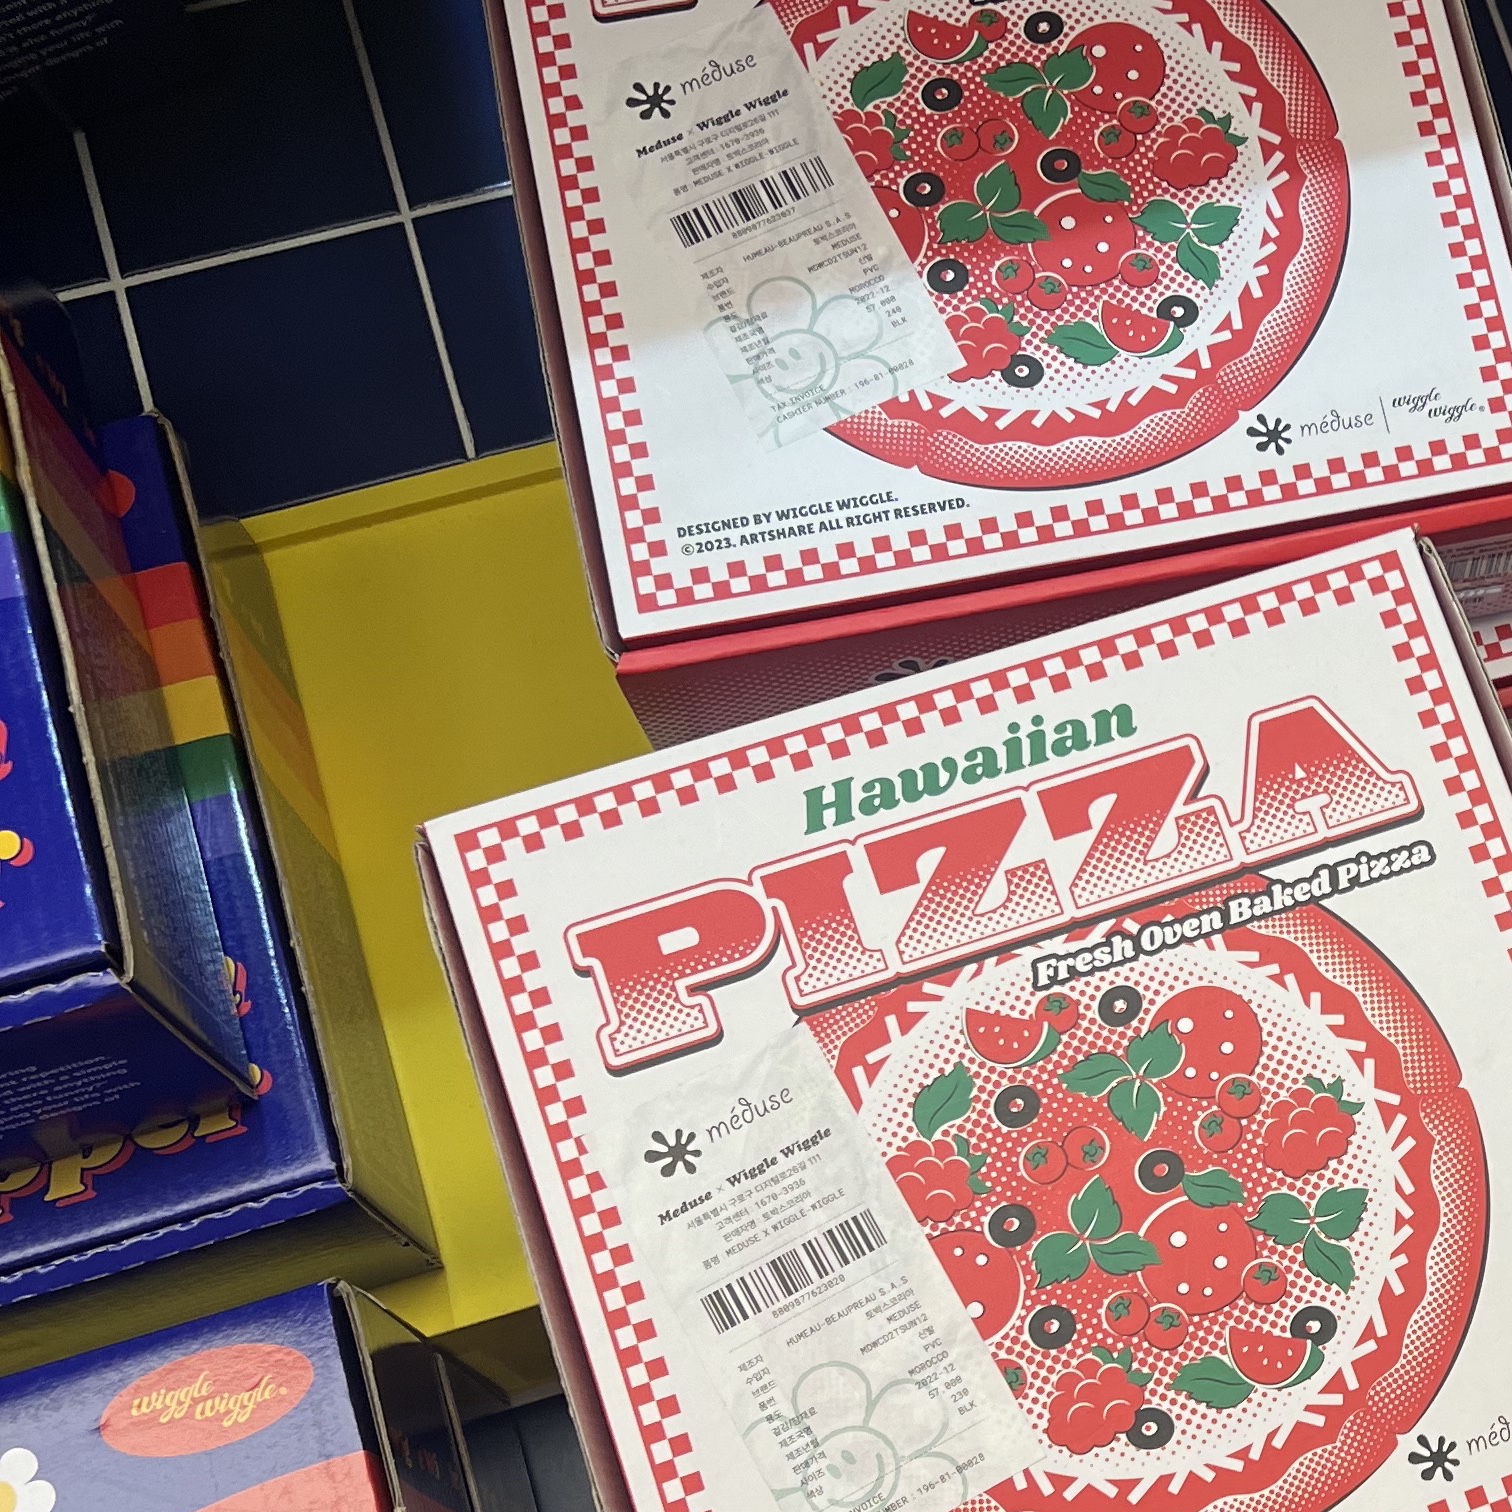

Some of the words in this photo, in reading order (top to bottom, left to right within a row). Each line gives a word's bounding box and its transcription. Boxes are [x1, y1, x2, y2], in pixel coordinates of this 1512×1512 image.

[680, 53, 756, 95] méduse
[636, 132, 683, 158] Meduse
[696, 108, 741, 131] Wiggle
[743, 88, 788, 111] Wiggle
[693, 170, 724, 186] MEDUSE
[831, 233, 862, 250] MEDUSE
[771, 400, 787, 412] TAX
[789, 384, 828, 405] INVOICE
[777, 400, 813, 423] CASHIER
[813, 389, 846, 407] NUMBER
[1392, 387, 1441, 413] wiggle
[1300, 409, 1374, 437] méduse
[677, 517, 749, 538] DESIGNED
[753, 512, 772, 525] BY
[775, 502, 834, 521] WIGGLE
[836, 491, 898, 510] WIGGLE.
[740, 523, 815, 546] ARTSHARE
[819, 519, 843, 532] ALL
[846, 510, 890, 527] RIGHT
[894, 497, 970, 519] RESERVED.
[804, 702, 1138, 835] Hawaiian
[565, 695, 1424, 1074] PIZZA
[1034, 933, 1136, 988] Fresh
[1139, 907, 1224, 955] Oven
[1227, 872, 1333, 925] Baked
[1336, 842, 1432, 892] Pizza
[706, 1085, 793, 1143] méduse
[658, 1190, 712, 1225] Meduse
[726, 1154, 778, 1188] Wiggle
[780, 1126, 832, 1159] Wiggle
[686, 1203, 728, 1230] 서울특별시
[729, 1190, 753, 1206] 구로구
[725, 1234, 761, 1257] MEDUSE
[762, 1229, 770, 1237] X
[771, 1188, 845, 1232] WIGGLE-WIGGLE
[737, 1354, 764, 1372] 제조자
[786, 1293, 876, 1347] HUMEAU-BEAUPREAU
[752, 1380, 776, 1398] 브랜드
[886, 1300, 922, 1324] MEDUSE
[923, 1338, 942, 1352] PVC
[745, 1367, 770, 1385] 수입자
[908, 1351, 948, 1377] MOROCCO
[912, 1363, 956, 1389] 2022-12
[131, 1371, 213, 1424] wiggle
[958, 1400, 976, 1415] BLK
[799, 1468, 825, 1490] 사이즈
